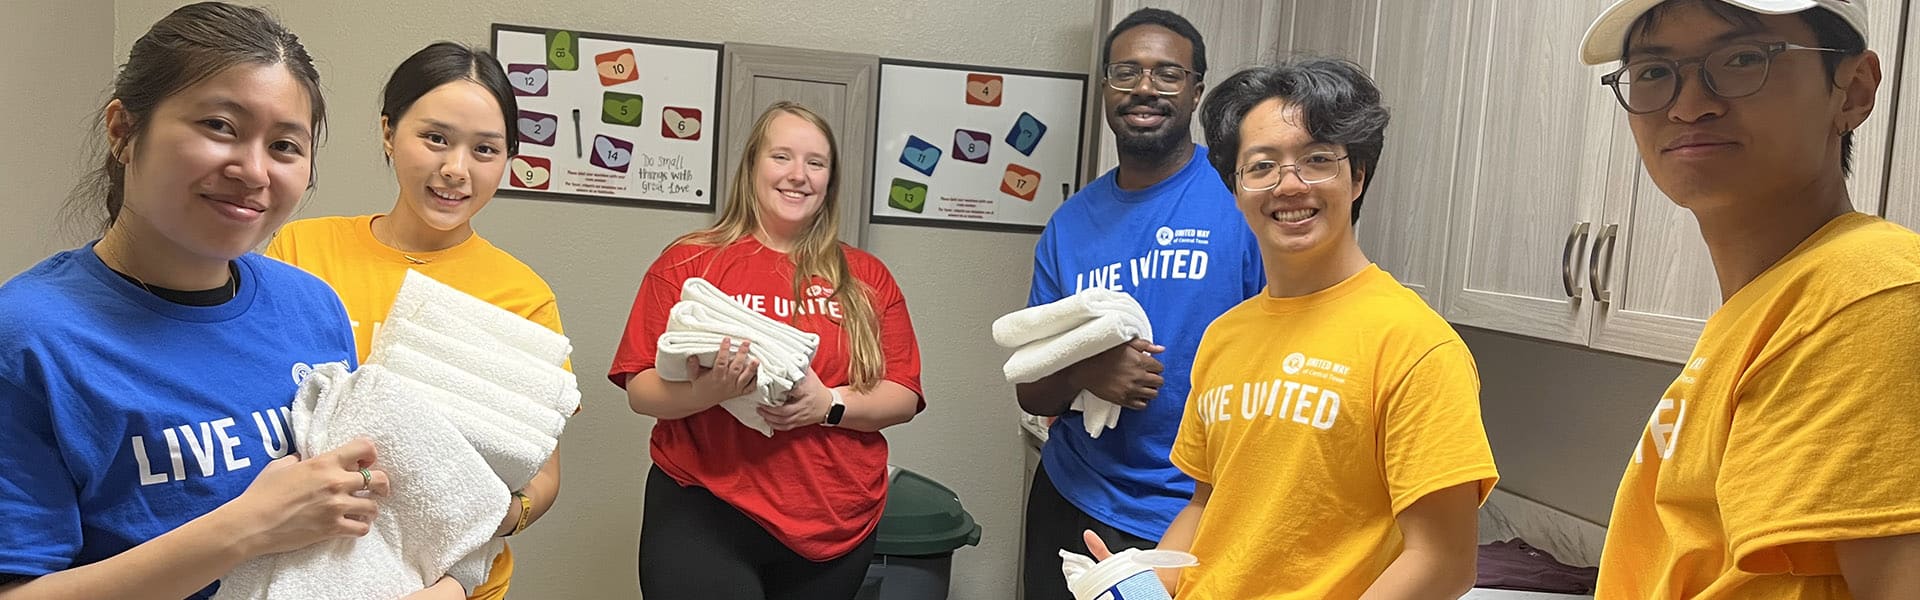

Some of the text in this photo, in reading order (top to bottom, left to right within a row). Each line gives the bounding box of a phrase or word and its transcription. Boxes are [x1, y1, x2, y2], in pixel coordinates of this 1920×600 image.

[555, 47, 566, 58] 18
[612, 63, 625, 75] 10
[524, 76, 535, 87] 12
[982, 86, 989, 96] 4
[620, 105, 628, 115] 5
[533, 124, 542, 135] 2
[677, 120, 686, 131] 6
[1022, 129, 1032, 138] 3
[968, 143, 976, 153] 8
[607, 150, 619, 162] 14
[642, 153, 655, 167] Do
[917, 154, 927, 164] 11
[526, 170, 534, 181] 9
[638, 167, 668, 183] things
[670, 169, 693, 181] with
[1015, 179, 1026, 190] 17
[904, 193, 914, 203] 13
[1075, 262, 1123, 295] LIVE
[774, 295, 843, 319] UNITE
[131, 416, 251, 487] LIVE
